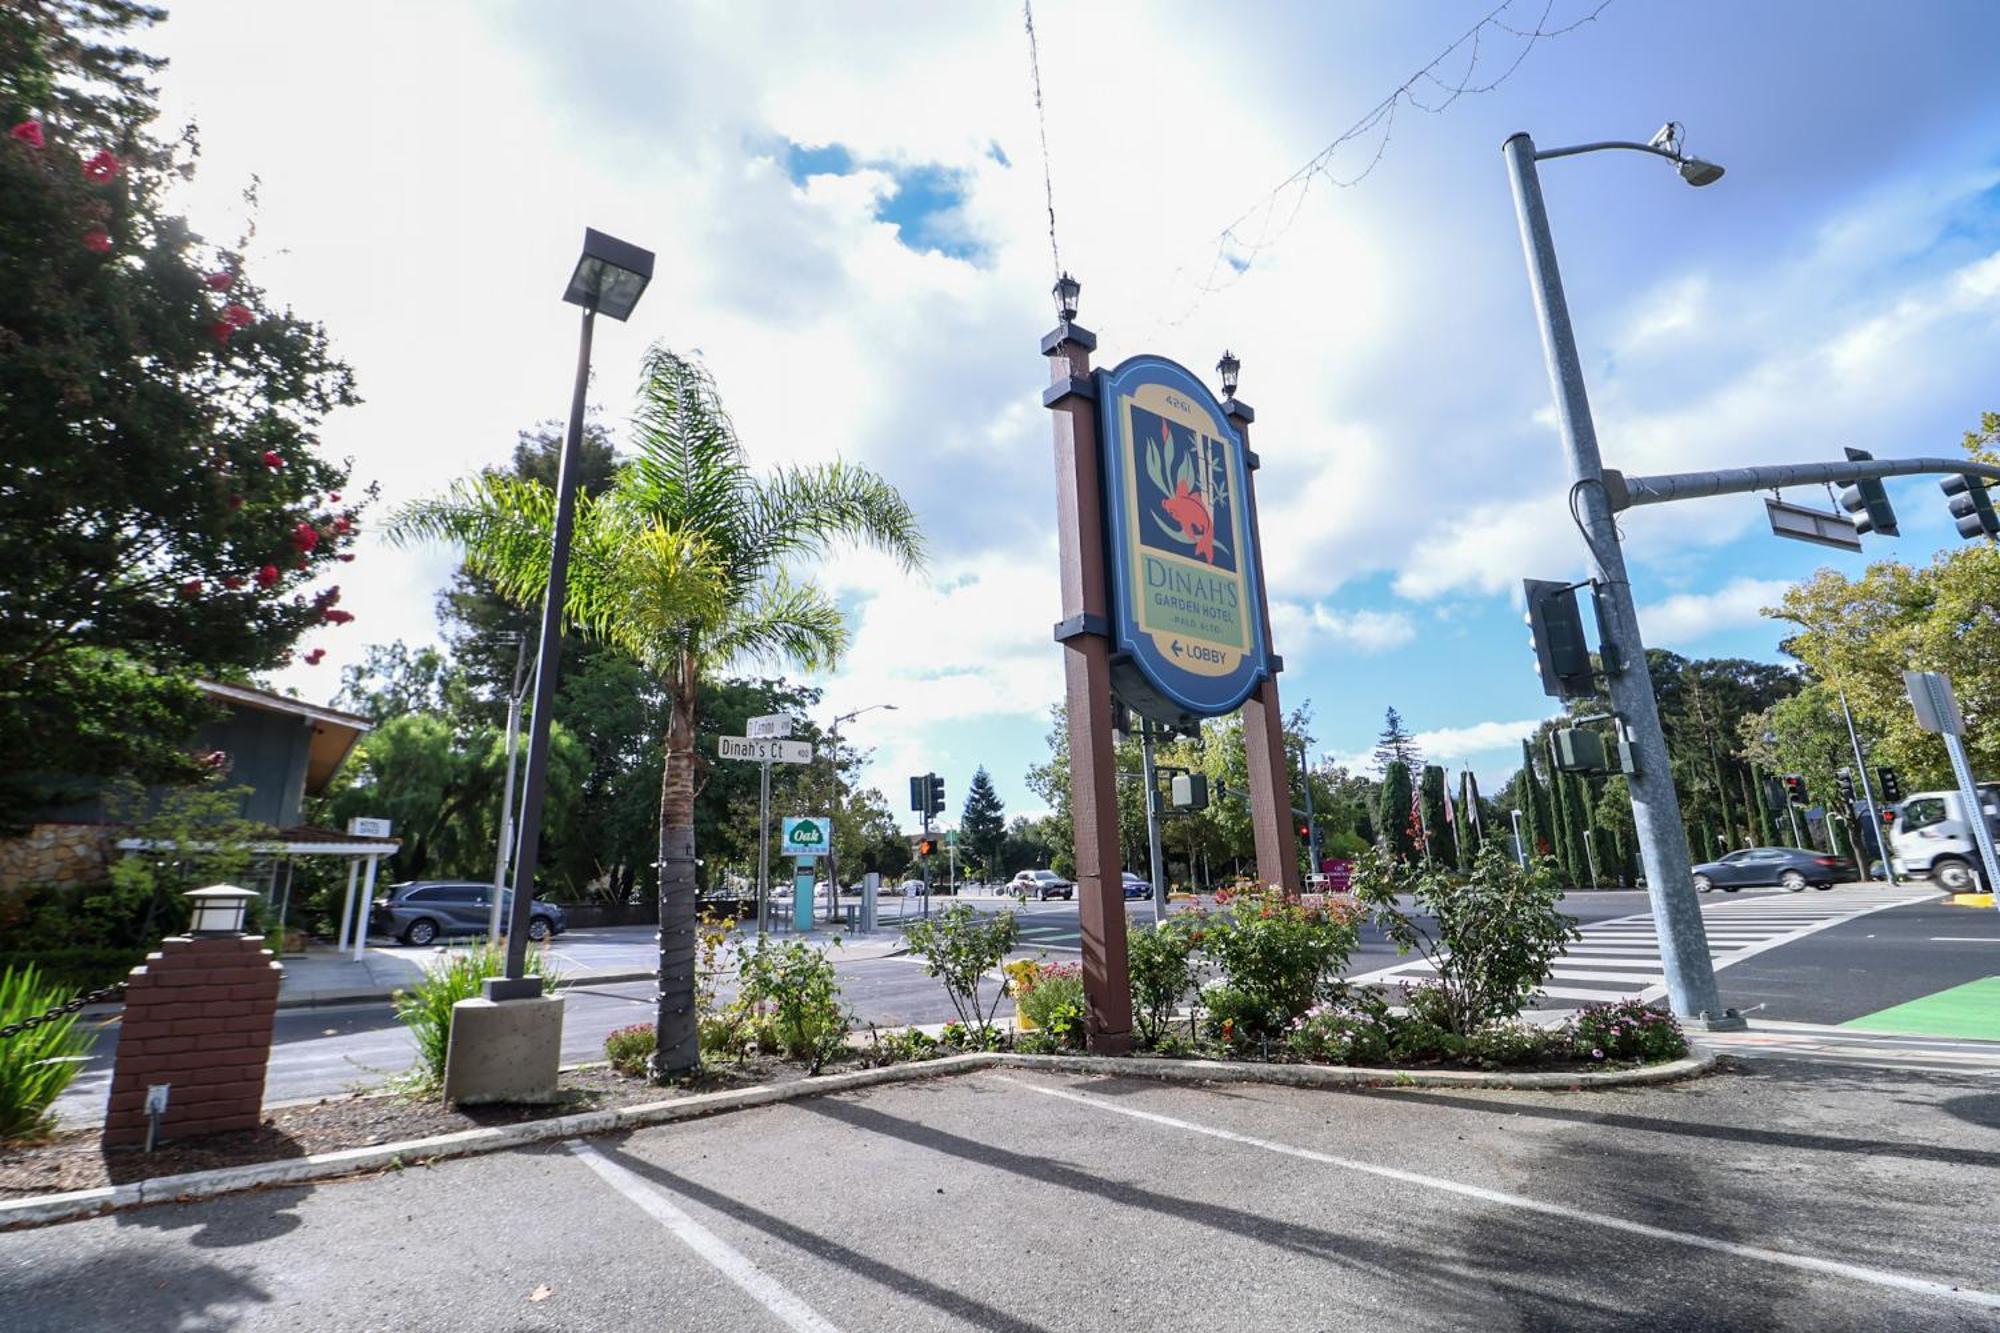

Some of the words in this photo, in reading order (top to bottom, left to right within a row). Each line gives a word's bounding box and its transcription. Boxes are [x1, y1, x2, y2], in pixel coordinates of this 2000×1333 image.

[1147, 557, 1238, 609] DINAH'S
[1154, 592, 1201, 615] GARDEN
[1202, 606, 1235, 625] HOTEL
[1186, 644, 1227, 665] LOBBY
[722, 738, 766, 758] Dinah's
[771, 742, 783, 759] Ct
[794, 829, 819, 842] Oak
